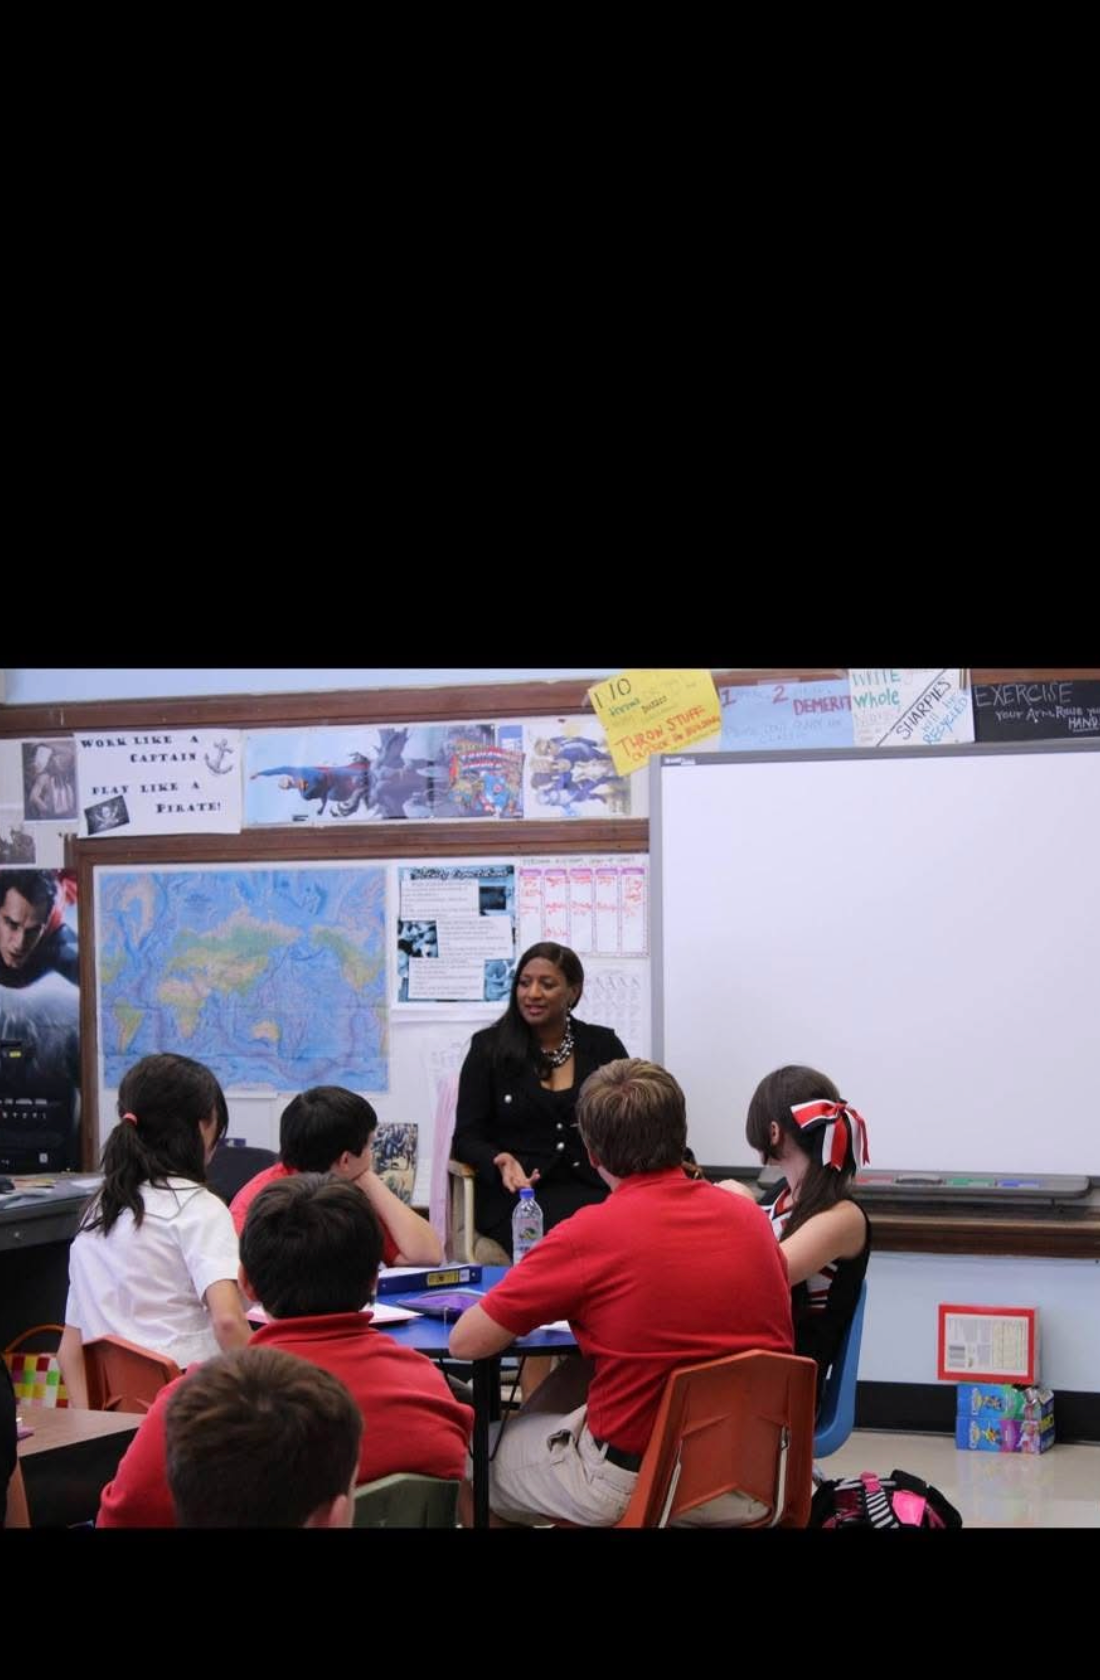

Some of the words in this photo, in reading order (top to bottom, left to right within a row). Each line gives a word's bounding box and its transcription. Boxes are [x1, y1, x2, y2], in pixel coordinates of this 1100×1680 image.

[974, 681, 1074, 707] EXERCISE
[895, 678, 952, 741] SHARPIES
[81, 738, 127, 748] WORK
[133, 736, 172, 745] LIKE
[190, 735, 199, 743] A
[130, 753, 196, 763] CAPTAIN
[92, 785, 129, 795] PLAY
[140, 783, 178, 793] LIKE
[192, 781, 199, 789] A
[156, 802, 221, 813] PIRATE!
